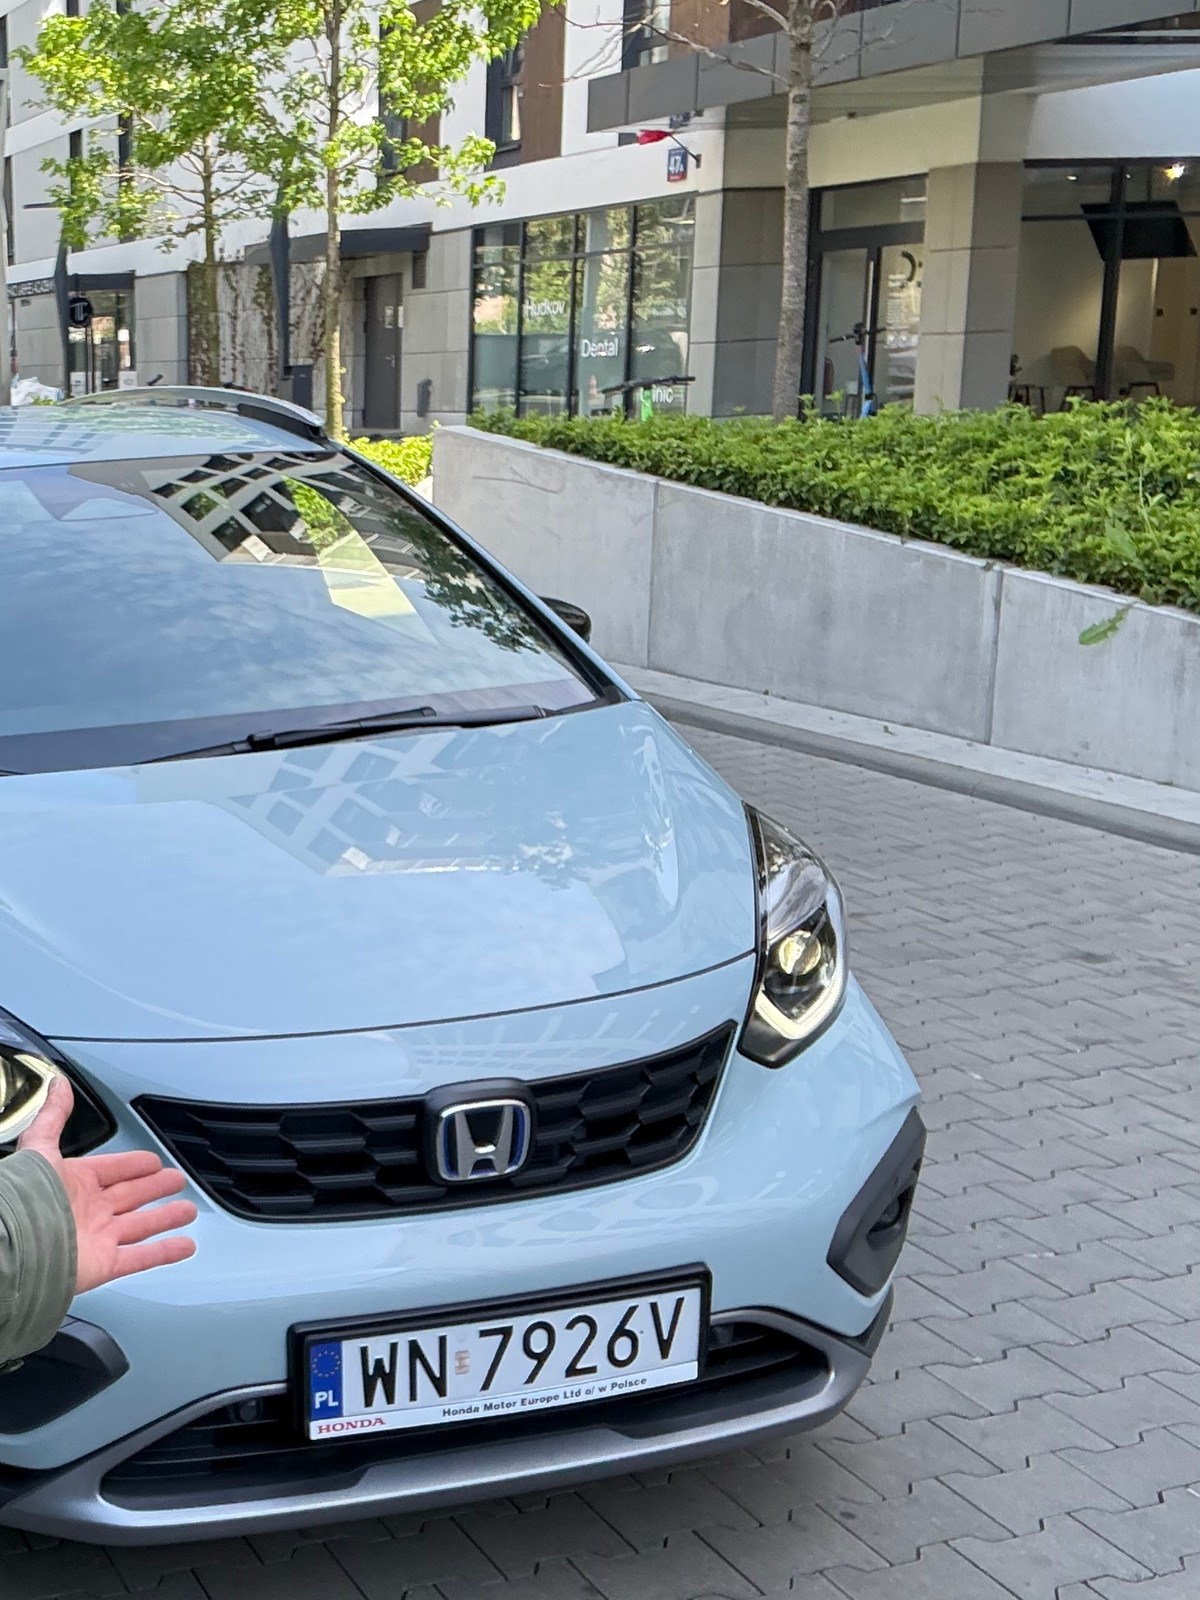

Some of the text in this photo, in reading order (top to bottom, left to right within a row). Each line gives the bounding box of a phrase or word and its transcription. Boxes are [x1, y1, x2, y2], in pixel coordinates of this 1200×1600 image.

[581, 338, 618, 357] Dental
[359, 1296, 685, 1408] WN 7926V
[314, 1390, 339, 1409] PL
[442, 1405, 479, 1418] Honda
[484, 1400, 517, 1412] Motor
[521, 1393, 560, 1407] Europe
[563, 1388, 582, 1400] Ltd
[611, 1376, 648, 1391] Polsce
[316, 1417, 386, 1435] HONDA
